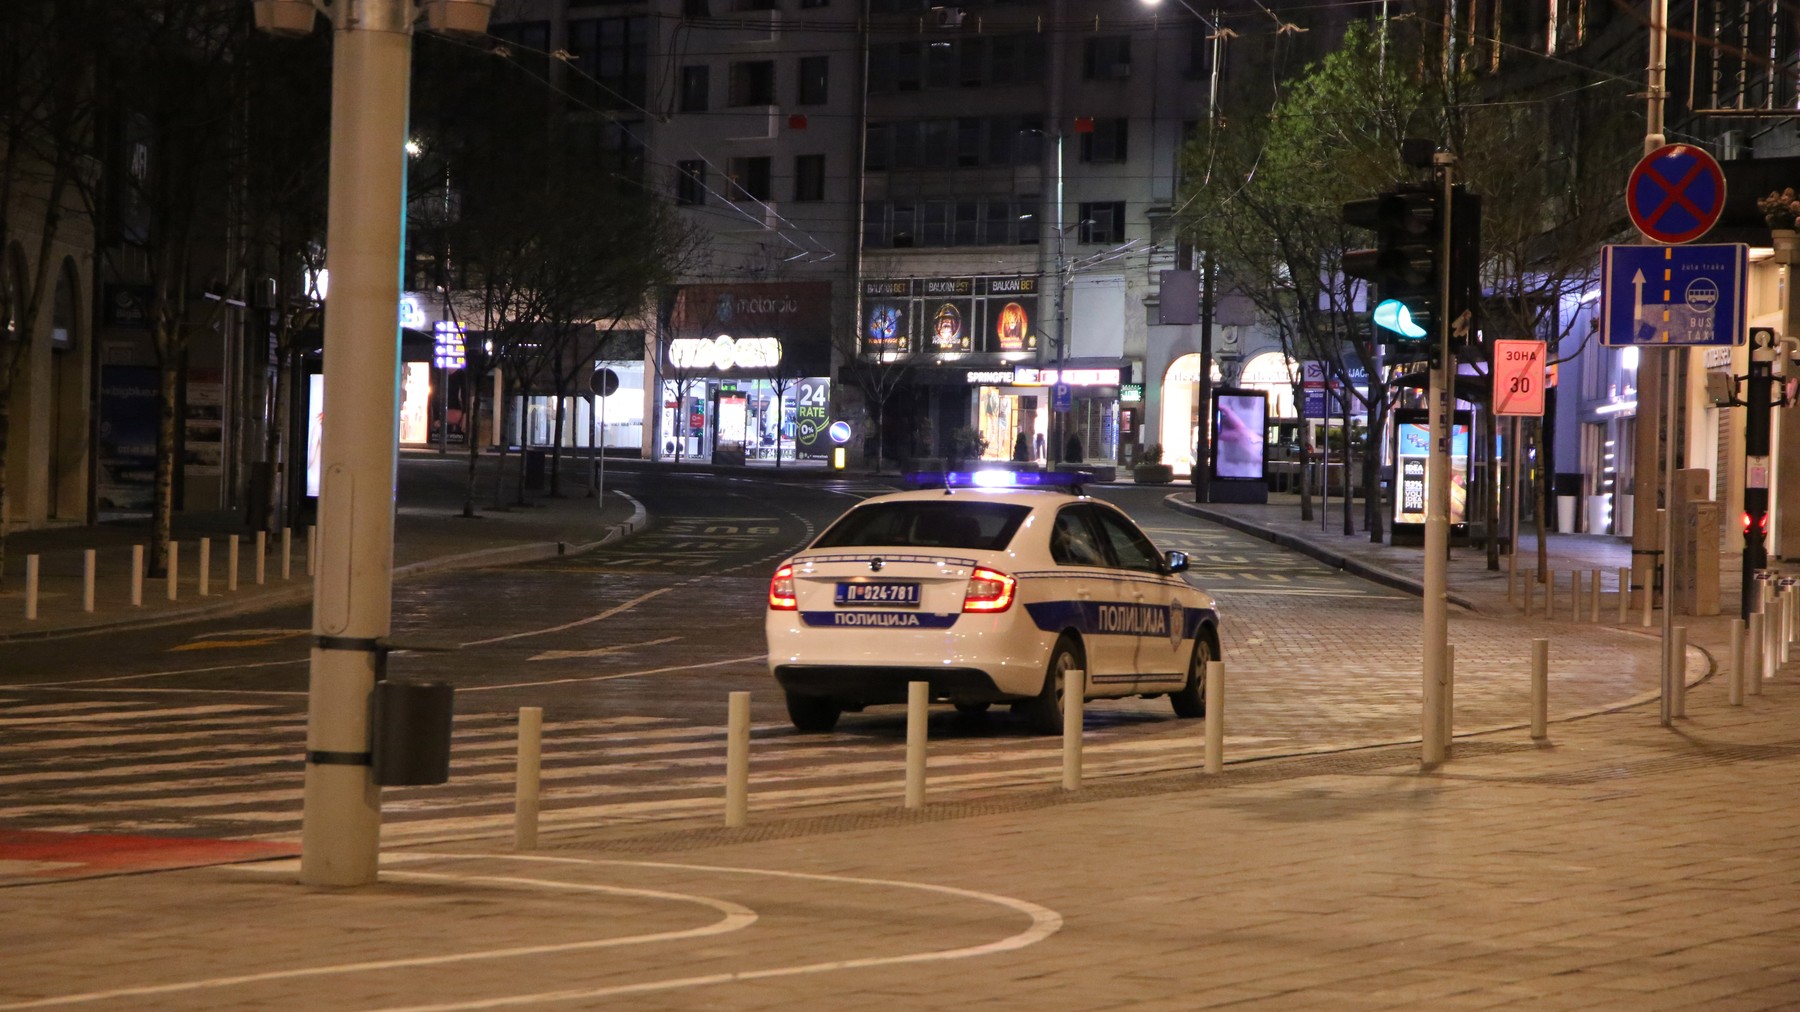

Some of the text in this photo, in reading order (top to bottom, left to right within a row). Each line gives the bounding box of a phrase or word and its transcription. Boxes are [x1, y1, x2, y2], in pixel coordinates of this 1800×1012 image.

[928, 281, 955, 293] BALKAN
[992, 279, 1034, 292] BALKAN BET
[1690, 317, 1712, 328] BUS
[1687, 330, 1715, 341] TAXI
[1506, 351, 1537, 361] ЗОНА
[1510, 377, 1529, 393] 30
[800, 384, 825, 406] 24
[800, 407, 825, 417] RATE
[801, 424, 814, 434] 0%
[834, 612, 919, 626] ПОЛИЦИЈА
[1099, 605, 1165, 633] ПОЛИЦИЈА
